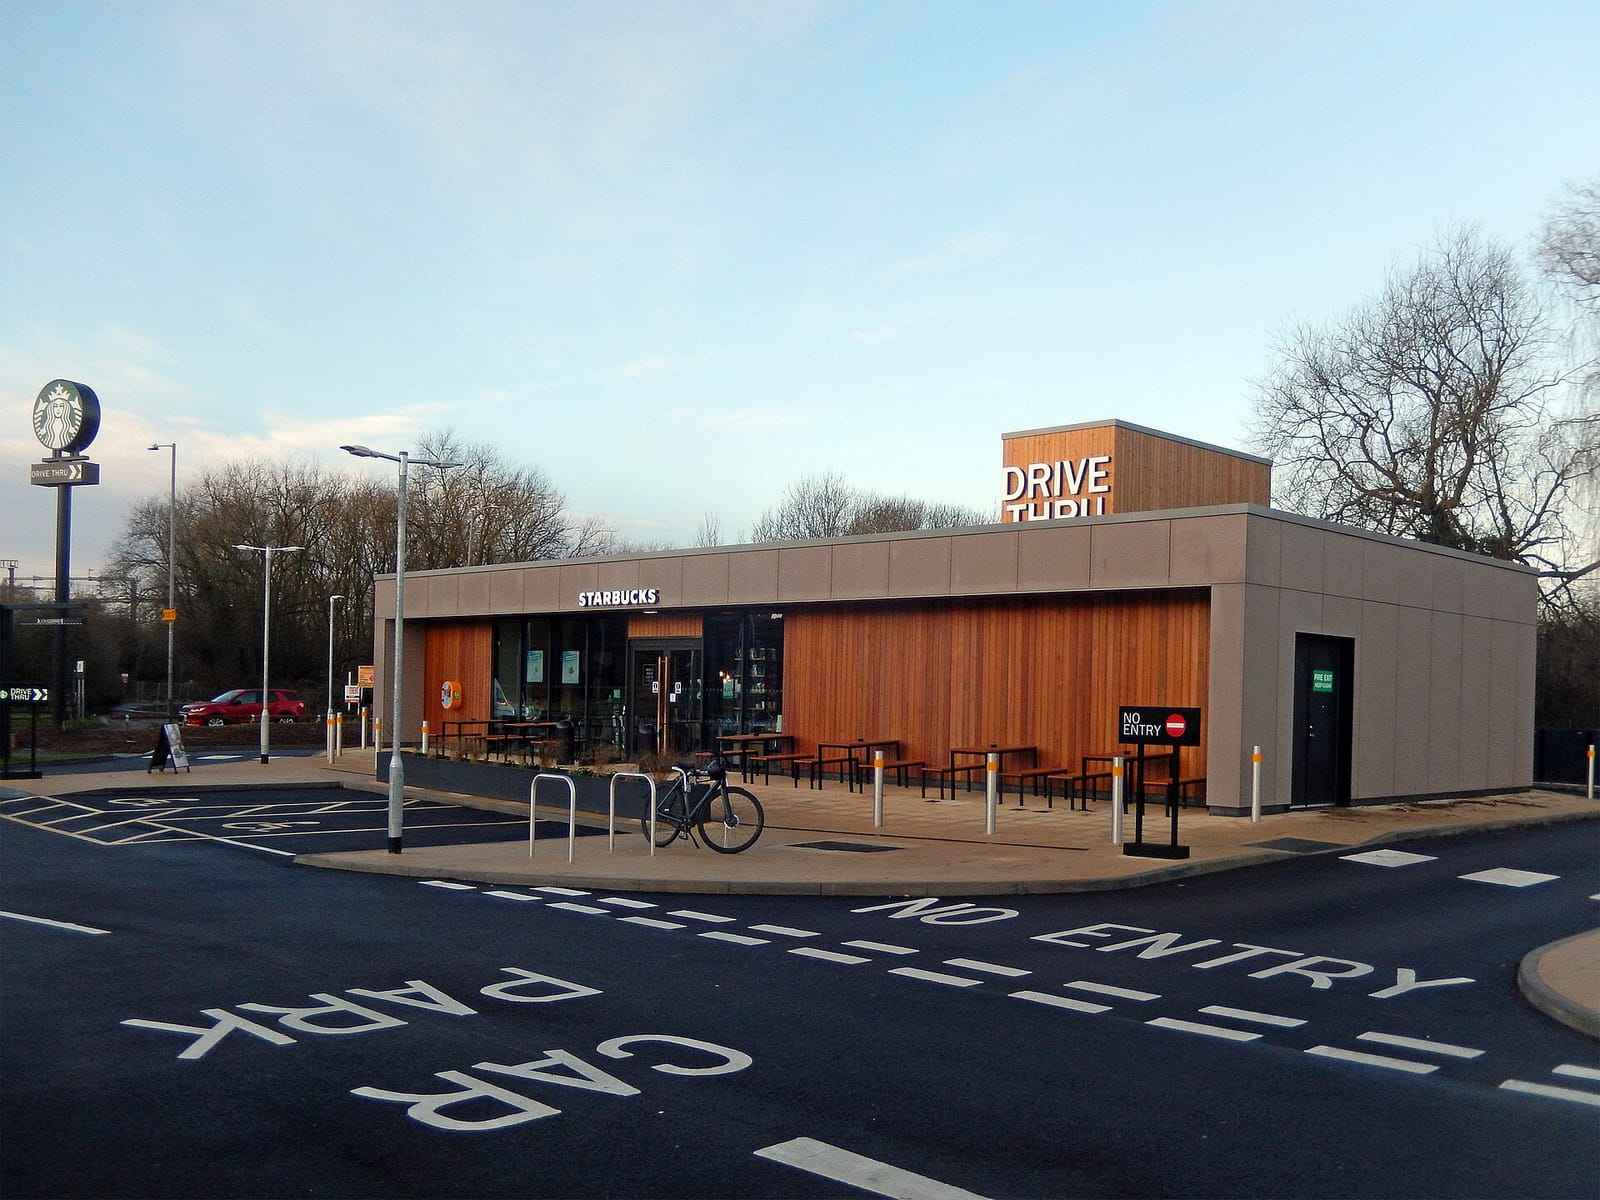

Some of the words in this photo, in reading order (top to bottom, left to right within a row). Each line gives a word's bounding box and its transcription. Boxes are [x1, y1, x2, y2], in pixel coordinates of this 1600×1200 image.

[31, 469, 50, 478] DRIVE
[51, 468, 68, 477] THRU
[1002, 456, 1110, 501] DRIVE
[578, 588, 656, 607] STARBUCKS
[1123, 712, 1141, 724] NO
[1123, 723, 1161, 737] ENTRY
[850, 898, 1020, 925] NO
[1030, 923, 1476, 999] ENTRY
[120, 967, 604, 1059] PARK
[350, 1034, 754, 1131] CAR
